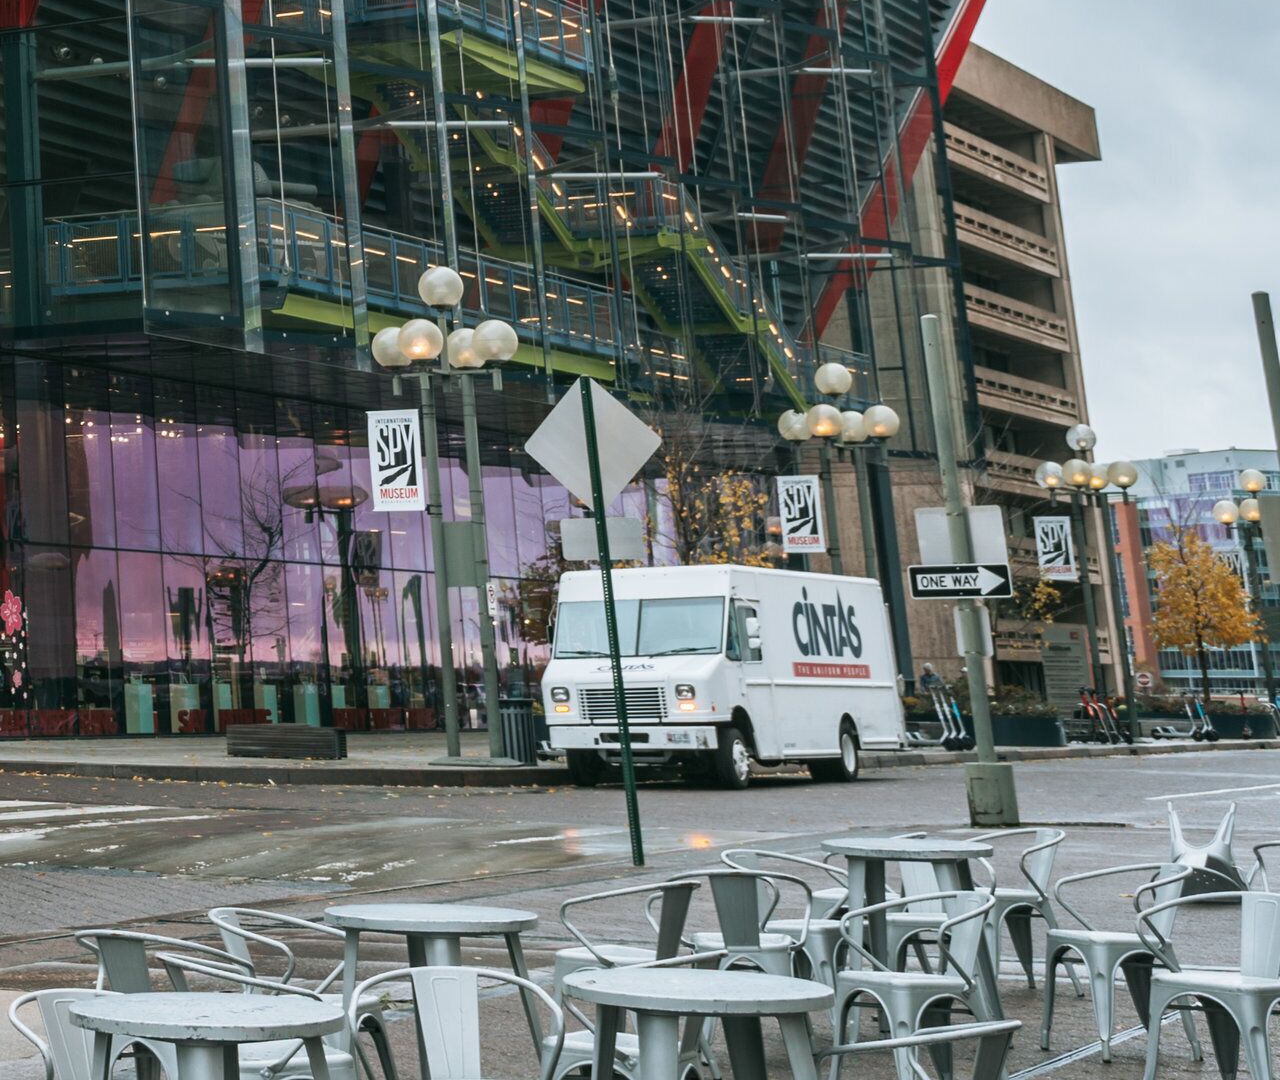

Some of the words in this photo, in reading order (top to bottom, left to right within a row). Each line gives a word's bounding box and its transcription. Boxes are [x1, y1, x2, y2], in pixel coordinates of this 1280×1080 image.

[376, 424, 415, 466] SPY
[380, 488, 419, 500] MUSEUM
[783, 485, 815, 518] SPY
[788, 536, 820, 545] MUSEUM
[1040, 524, 1067, 552] SPY
[920, 576, 947, 588] ONE
[951, 575, 979, 587] WAY
[792, 585, 862, 659] CINTAS
[797, 665, 810, 674] THE
[813, 666, 842, 675] UNIFORM
[843, 667, 867, 676] PEOPLE
